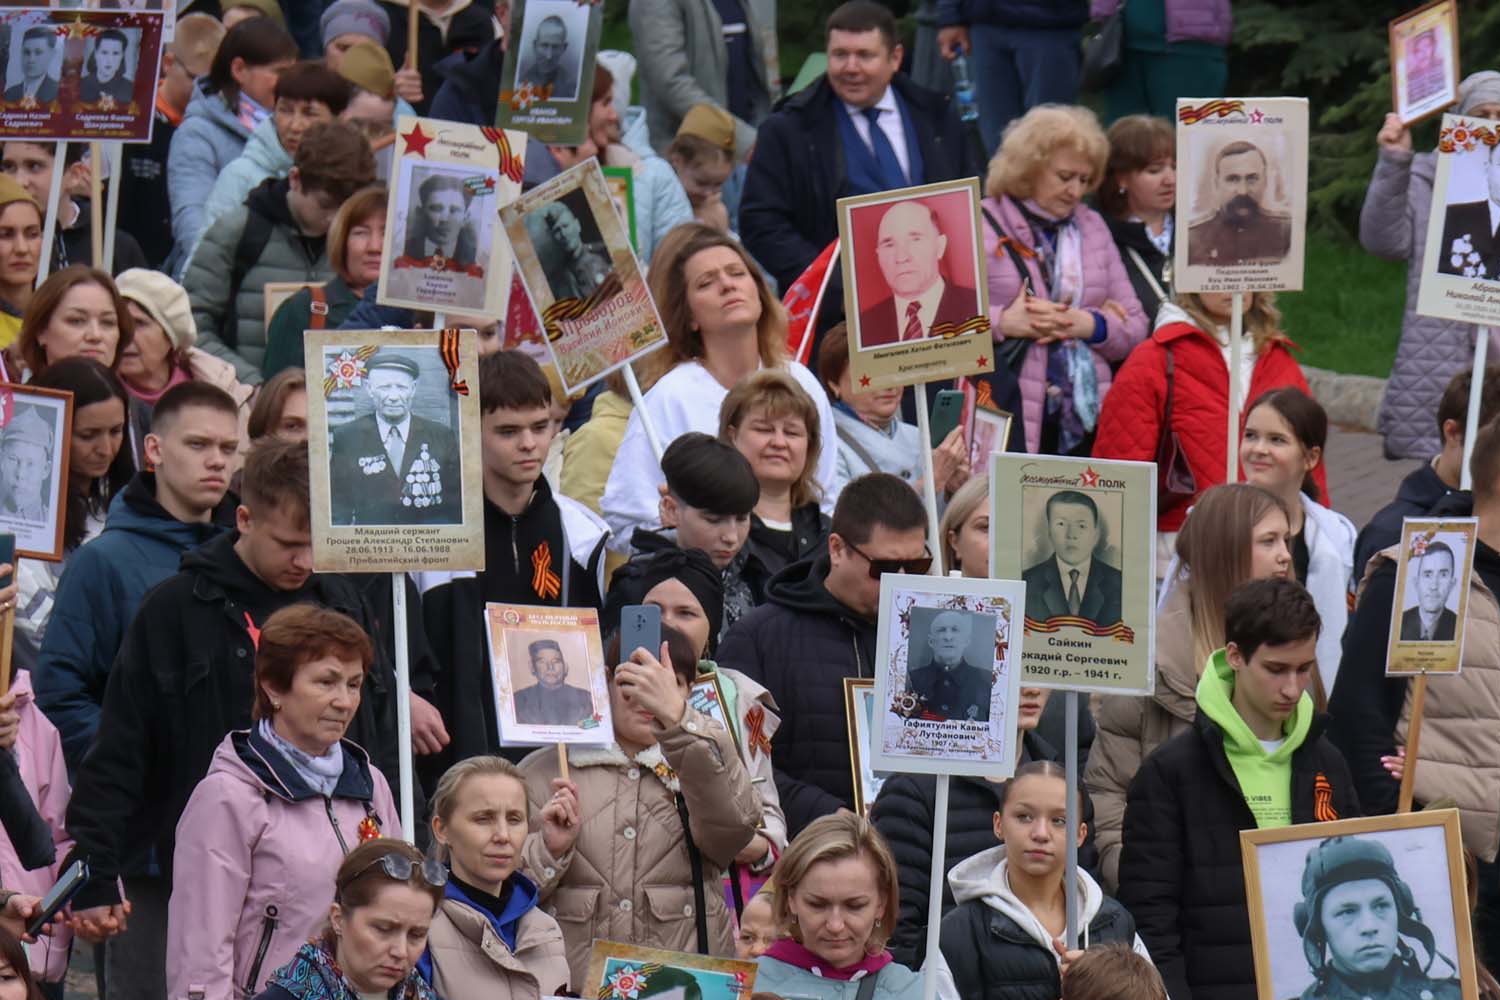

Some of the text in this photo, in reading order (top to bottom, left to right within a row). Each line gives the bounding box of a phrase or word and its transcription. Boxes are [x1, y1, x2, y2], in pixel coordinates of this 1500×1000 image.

[1098, 478, 1126, 490] ПОЛК
[354, 527, 440, 538] Младший сержант
[327, 536, 470, 548] Грошев Александр Степанович
[345, 546, 393, 554] 28.06.1913
[349, 555, 449, 567] Прибалтийский фронт
[1047, 636, 1092, 649] Сайкин
[1021, 650, 1128, 667] ркадий Сергеевич
[1025, 665, 1051, 675] 1920
[1085, 669, 1110, 680] 1941
[918, 730, 977, 741] Лутфанович
